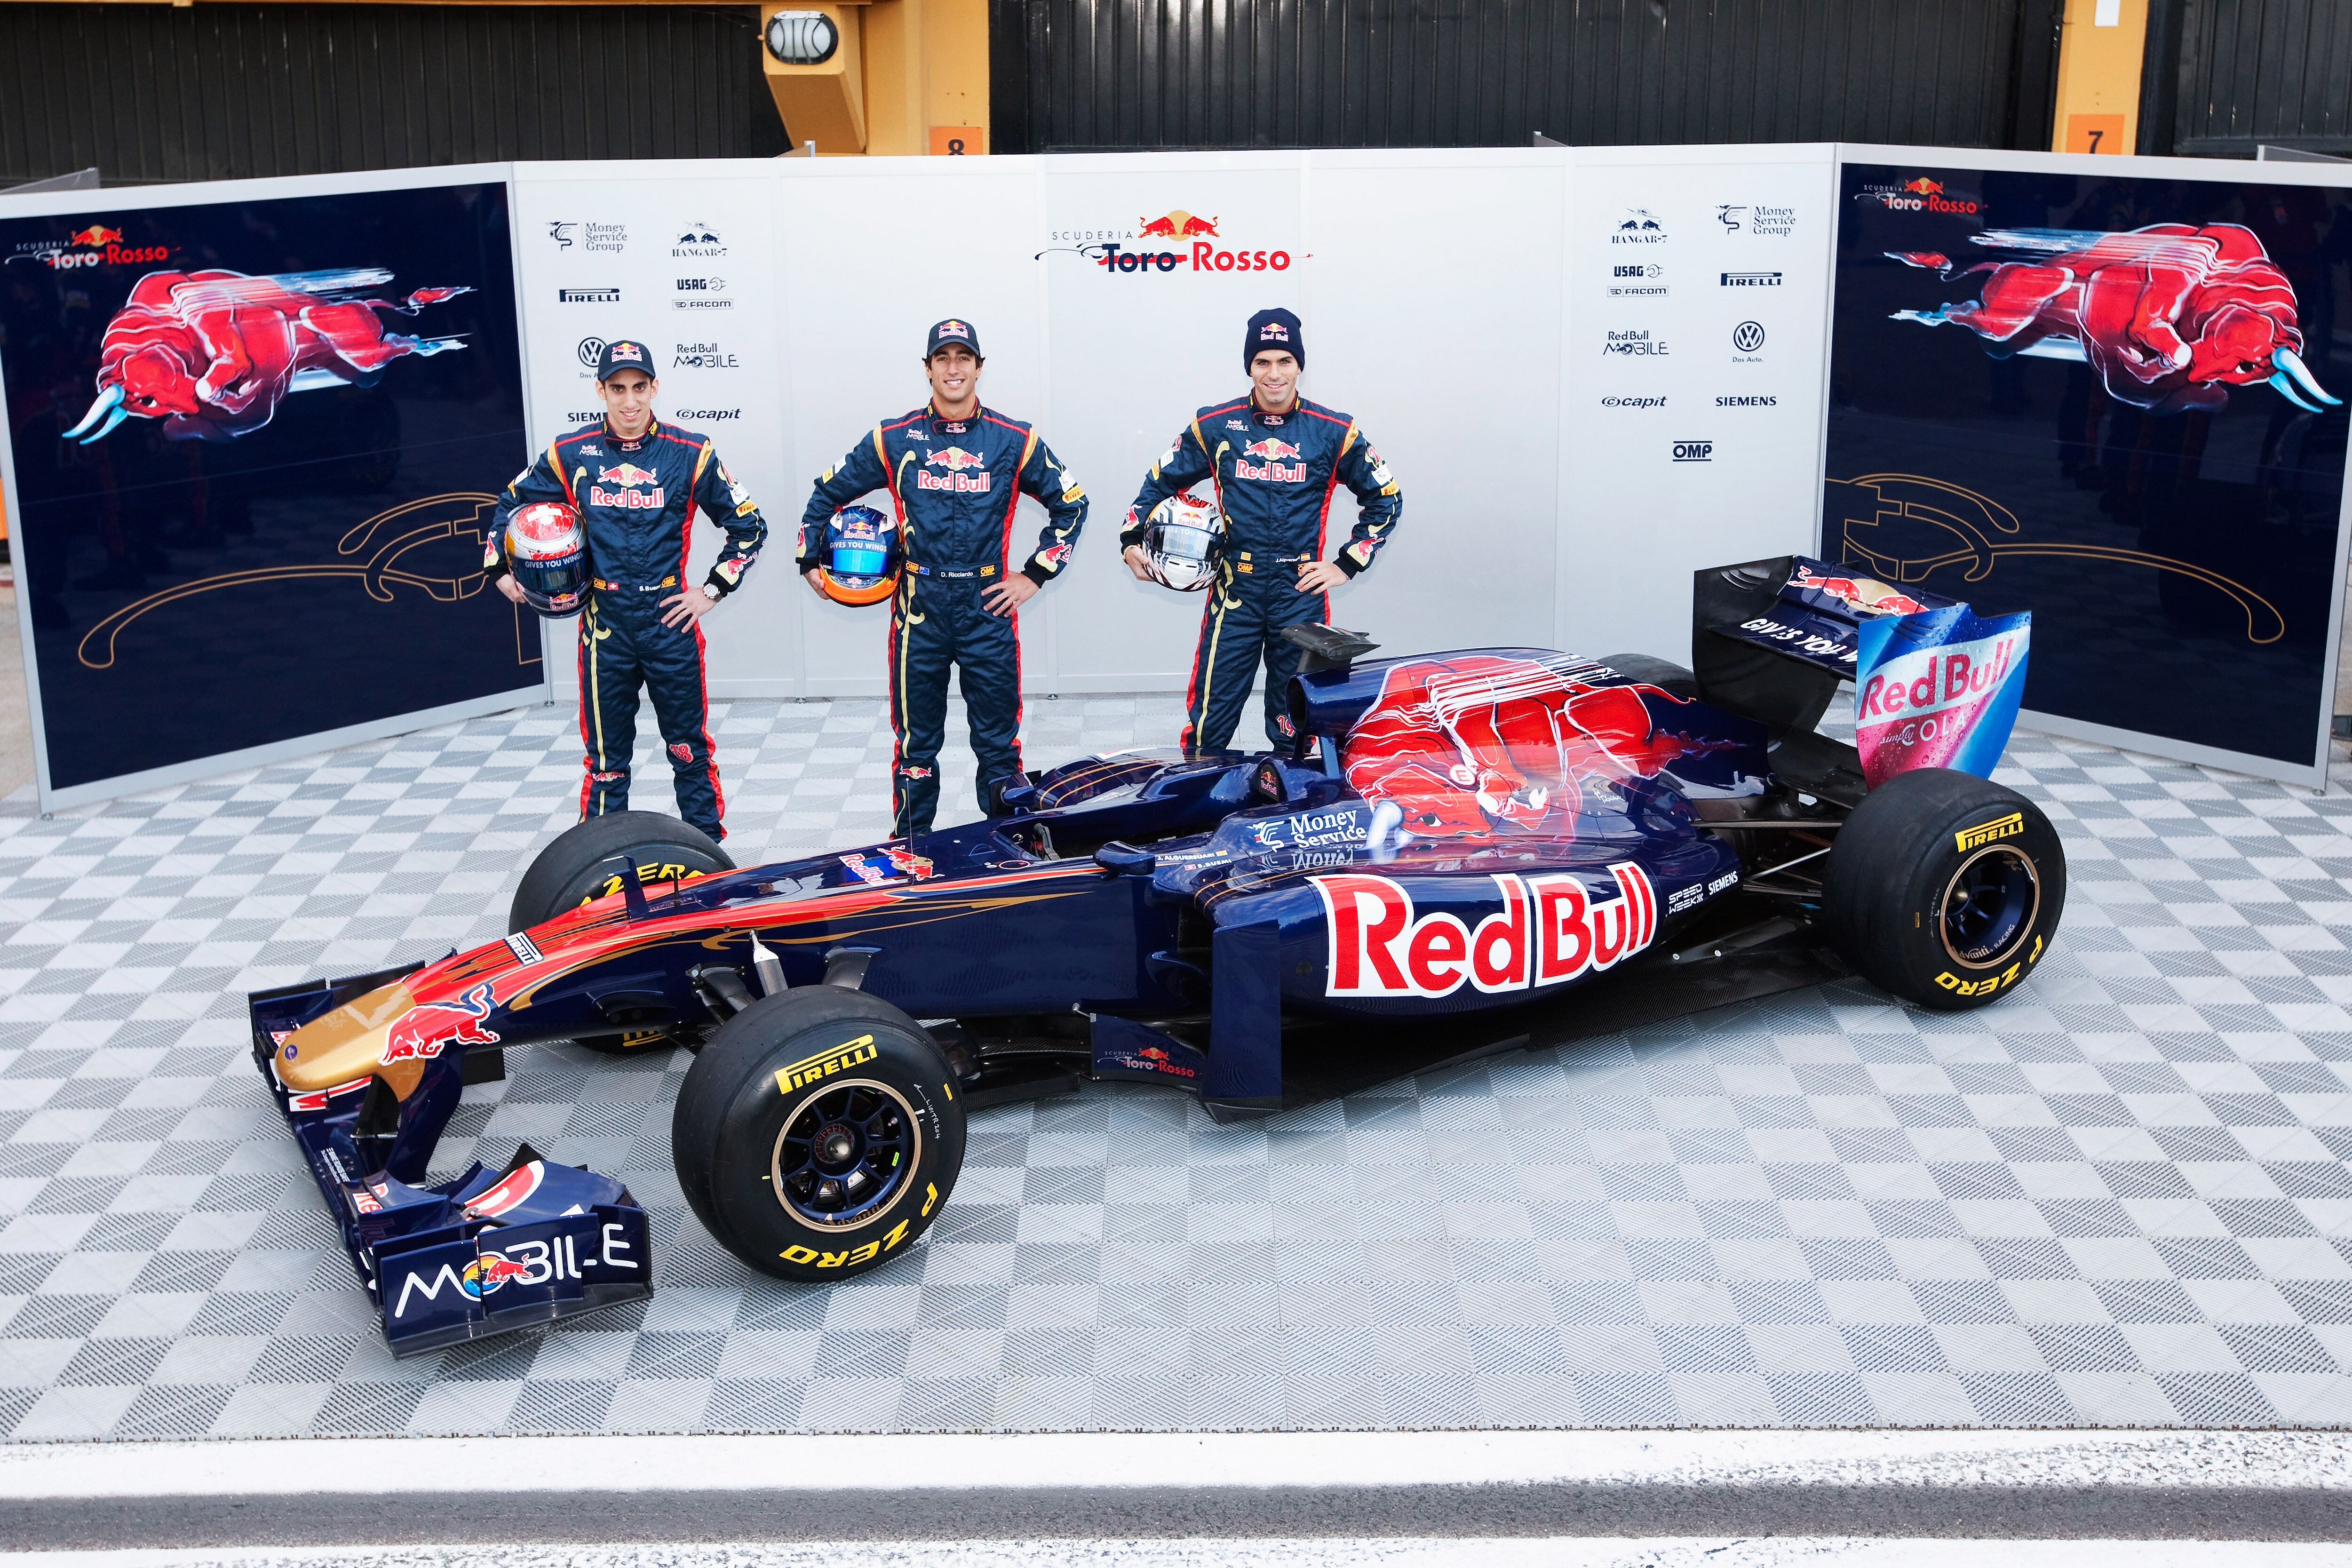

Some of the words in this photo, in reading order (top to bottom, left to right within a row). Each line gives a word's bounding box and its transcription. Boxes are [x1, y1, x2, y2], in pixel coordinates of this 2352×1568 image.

[2089, 131, 2103, 154] 7
[1887, 192, 1922, 211] Toro
[1929, 194, 1977, 214] Rosso
[1755, 207, 1795, 216] Money
[1754, 216, 1796, 225] Service
[585, 223, 625, 233] Money
[1754, 226, 1790, 236] Group
[586, 232, 627, 241] Service
[1052, 231, 1133, 240] SCUDERIA
[1612, 235, 1667, 244] HANGAR-7
[16, 239, 70, 251] SCUDERIA
[586, 242, 623, 253] Group
[49, 249, 99, 270] Toro
[106, 244, 168, 265] Rosso
[672, 248, 727, 257] HANGAR-7
[1102, 243, 1176, 272] Toro
[1193, 241, 1290, 271] Rosso
[1614, 266, 1644, 277] USAG
[677, 279, 707, 290] USAG
[1721, 272, 1782, 286] PIRELLI
[559, 288, 620, 302] PIRELLI
[939, 330, 953, 338] Red
[954, 329, 968, 338] Bull
[1276, 333, 1288, 342] Bull
[1609, 331, 1628, 341] Red
[1630, 330, 1649, 340] Bull
[677, 344, 696, 353] Red
[698, 343, 717, 353] Bull
[1603, 342, 1669, 356] MOBILE
[674, 355, 739, 368] MOBILE
[1716, 397, 1777, 406] SIEMENS
[568, 412, 607, 422] SIEM
[1673, 445, 1712, 458] OMP
[1237, 460, 1270, 479] Red
[1272, 463, 1305, 481] Bull
[919, 471, 953, 489] Red
[956, 473, 989, 491] Bull
[591, 487, 626, 506] Red
[629, 488, 663, 507] Bull
[860, 532, 875, 541] Bull
[865, 543, 887, 552] WINGS
[545, 559, 561, 568] YOU
[563, 551, 583, 565] WINGS
[906, 562, 919, 572] OMP
[980, 566, 994, 575] OMP
[594, 580, 606, 588] OMP
[661, 577, 675, 586] OMP
[1794, 635, 1847, 654] YOU
[1859, 656, 1938, 721] Red
[1943, 638, 2013, 702] Bull
[1880, 728, 1914, 747] simply
[1902, 711, 1966, 746] COLA
[669, 742, 693, 763] 18
[1455, 770, 1470, 781] E
[1288, 809, 1357, 836] Money
[1295, 826, 1367, 848] Service
[1955, 812, 2023, 852] PIRELLI
[841, 853, 879, 872] Red
[1164, 852, 1215, 861] ALGUERSUARI
[859, 870, 897, 886] Bull
[1708, 870, 1738, 896] SIEMENS
[1669, 883, 1702, 904] SPEED
[1669, 896, 1697, 915] WEEK
[1316, 875, 1526, 993] Red
[1536, 865, 1654, 979] Bull
[1994, 923, 2015, 948] RACING
[505, 931, 543, 965] PIRELLI
[2029, 935, 2042, 963] P
[1934, 962, 2021, 996] ZERO
[774, 1034, 877, 1095] PIRELLI
[1124, 1056, 1153, 1070] Toro
[1159, 1060, 1194, 1077] Rosso
[922, 1182, 938, 1217] P
[779, 1218, 909, 1268] ZERO
[395, 1224, 638, 1318] MOBILE
